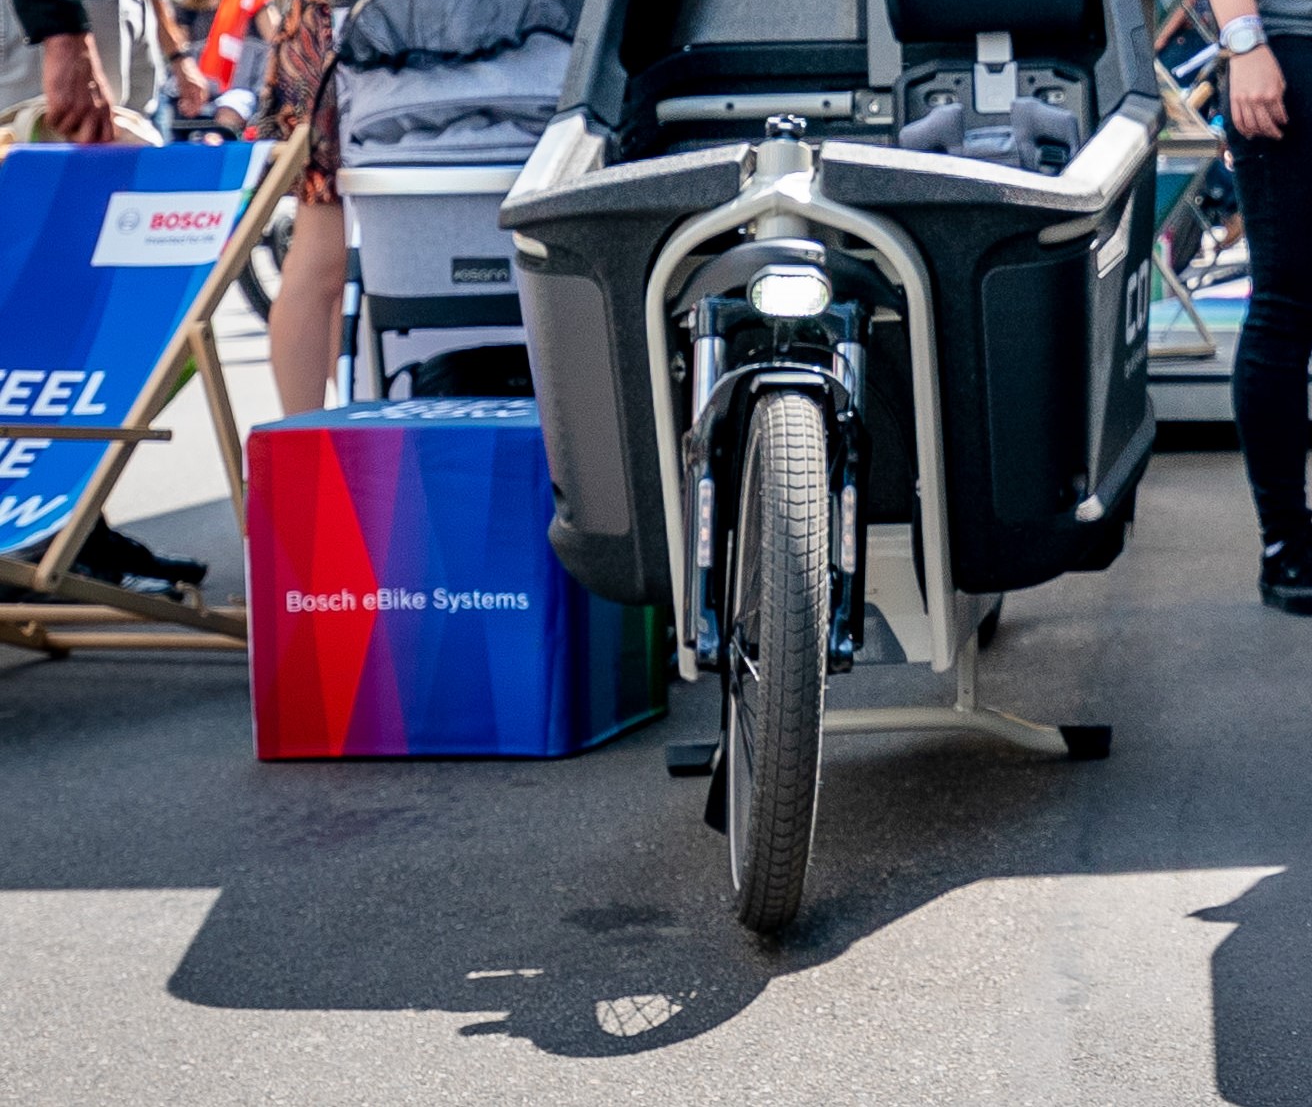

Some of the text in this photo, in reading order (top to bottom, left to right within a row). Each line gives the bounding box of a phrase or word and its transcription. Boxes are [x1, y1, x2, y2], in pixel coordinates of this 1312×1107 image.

[150, 212, 223, 232] BOSCH
[286, 587, 531, 614] Bosch eBike Systems
